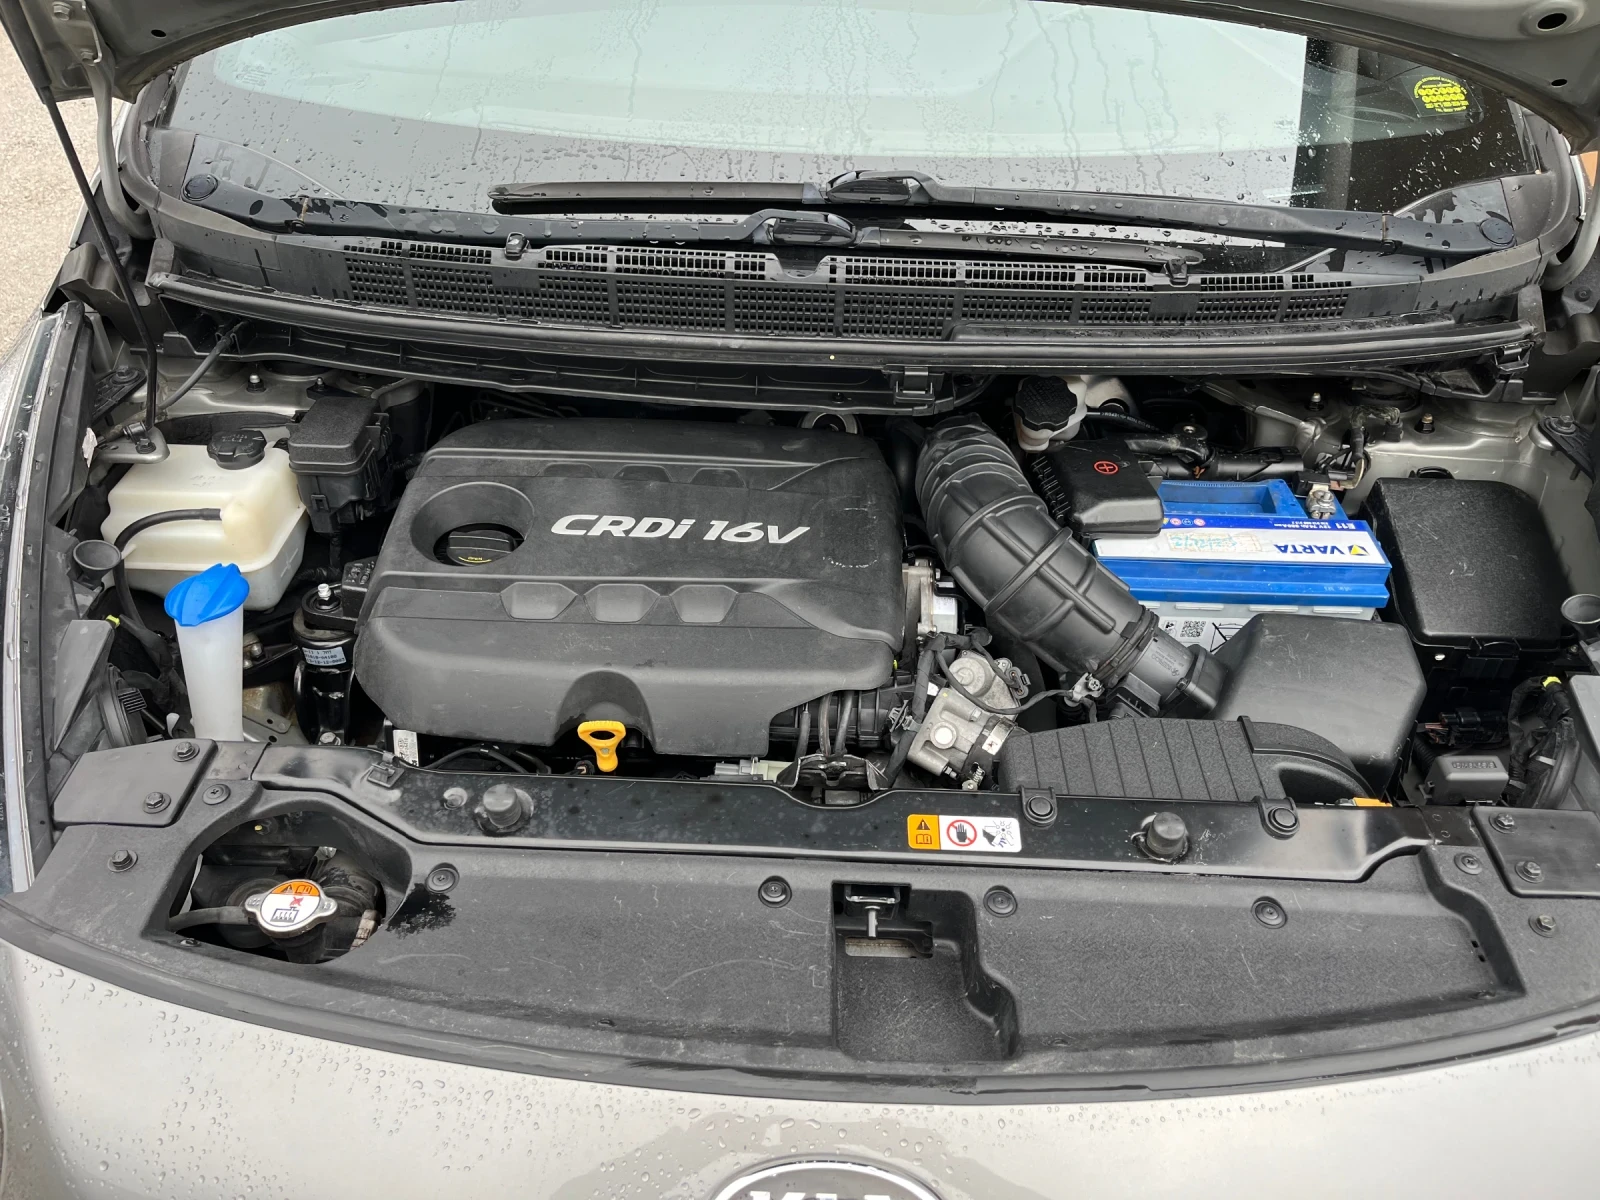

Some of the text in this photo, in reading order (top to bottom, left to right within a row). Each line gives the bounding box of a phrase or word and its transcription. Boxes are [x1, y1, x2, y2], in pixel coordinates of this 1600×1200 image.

[550, 514, 811, 544] CRDi 16V
[1335, 522, 1356, 530] E11
[1273, 544, 1346, 555] VARTA
